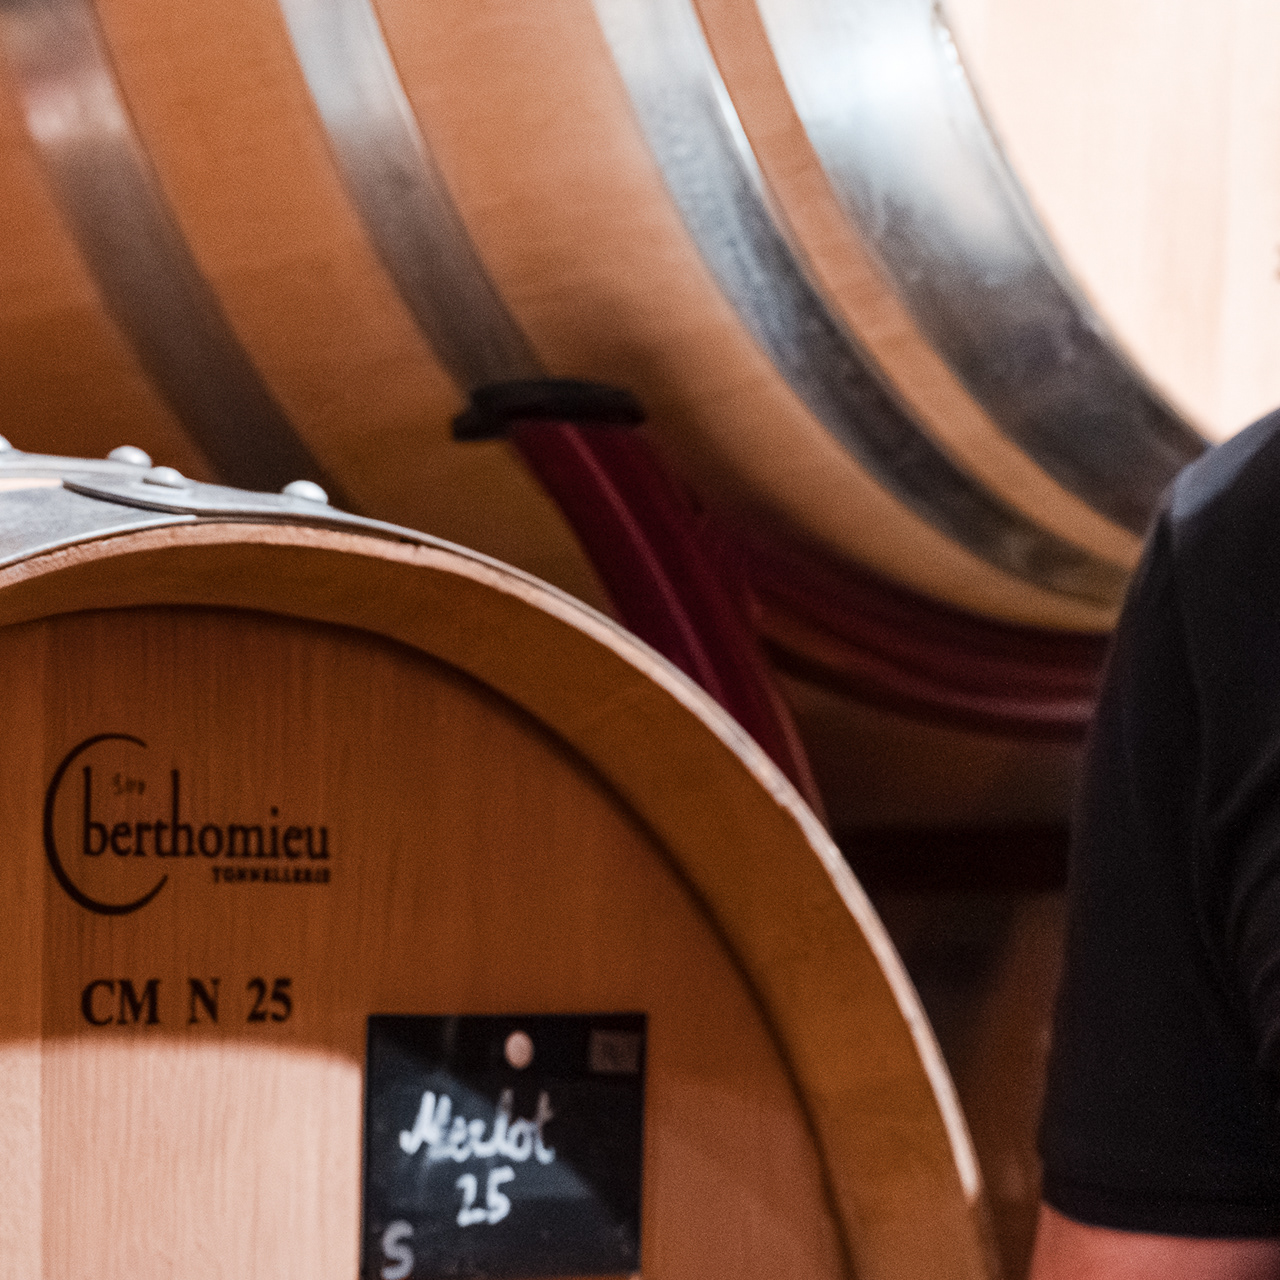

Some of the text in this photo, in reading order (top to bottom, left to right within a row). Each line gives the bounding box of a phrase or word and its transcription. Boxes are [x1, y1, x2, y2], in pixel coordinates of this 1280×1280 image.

[82, 765, 331, 860] berthomieu
[81, 976, 293, 1026] CM N 25
[399, 1088, 556, 1164] Merlot
[455, 1165, 515, 1227] 25
